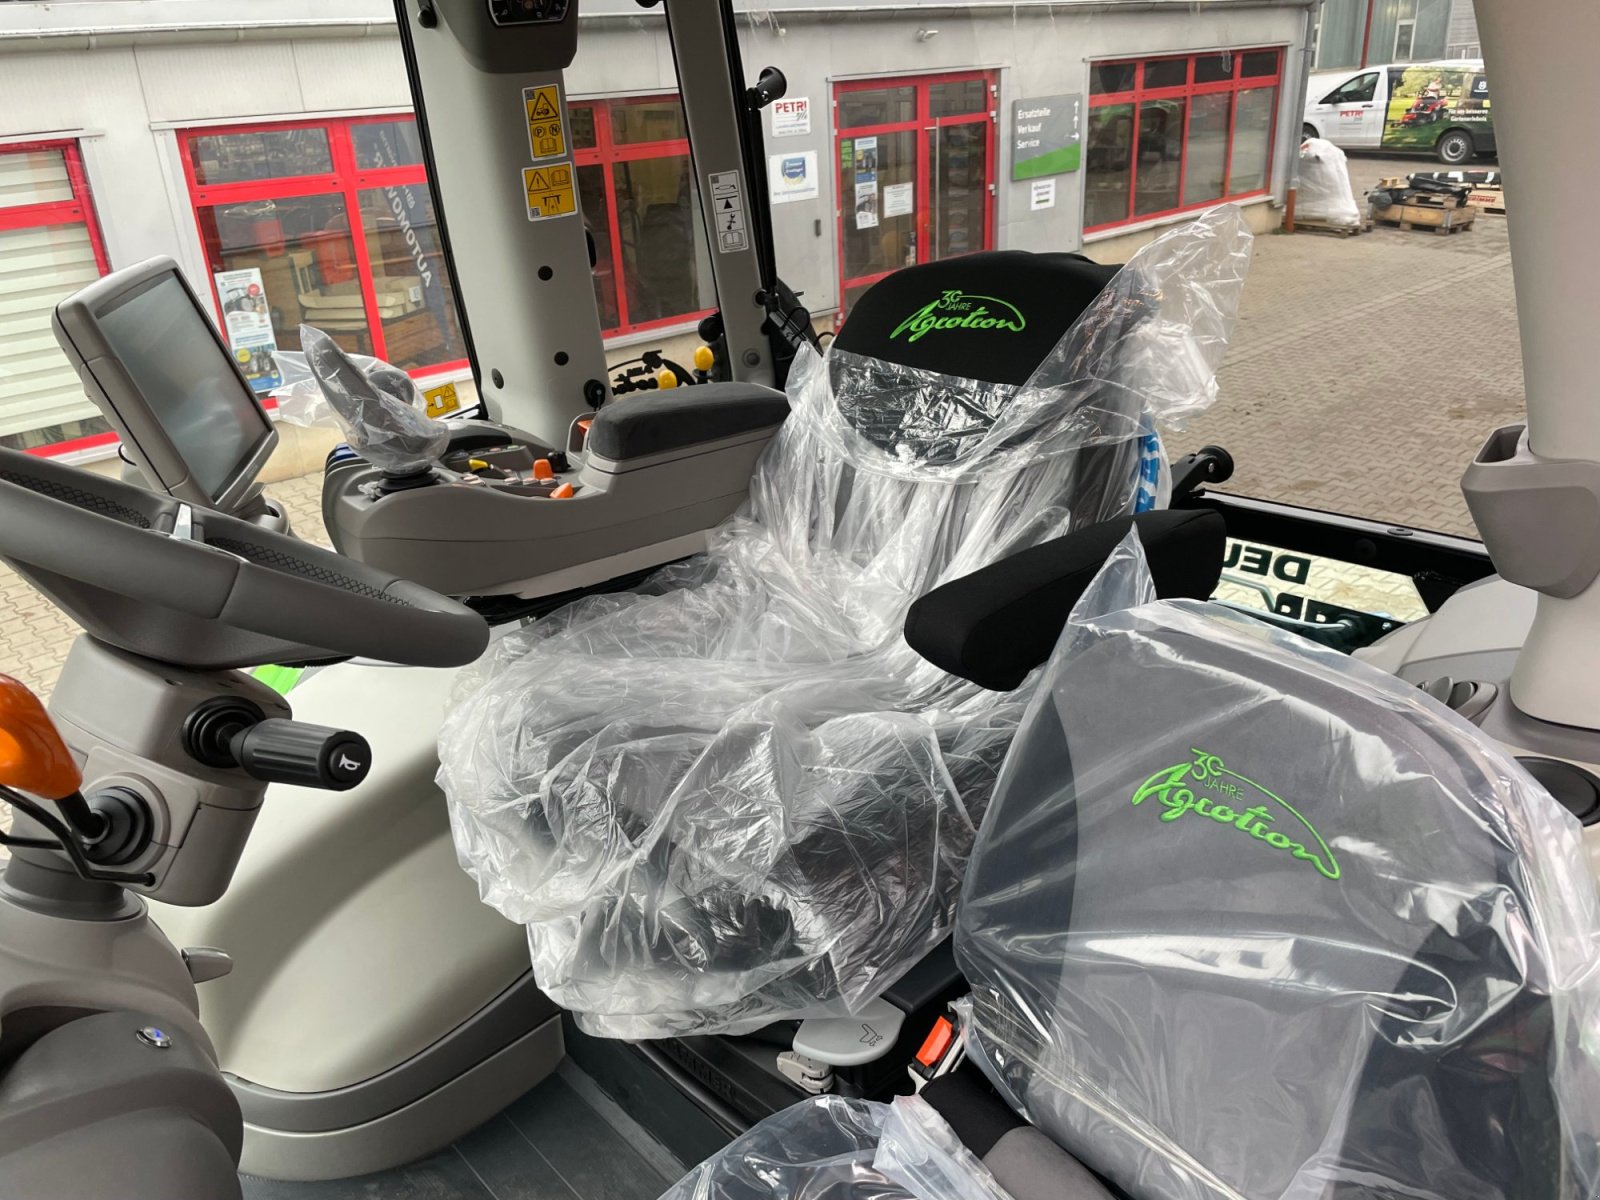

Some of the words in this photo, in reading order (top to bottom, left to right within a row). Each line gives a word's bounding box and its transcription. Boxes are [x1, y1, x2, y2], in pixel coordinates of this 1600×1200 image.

[775, 100, 807, 113] PETRI
[1017, 107, 1051, 119] Ersatzteile
[1017, 122, 1042, 134] Verkauf
[1016, 139, 1040, 149] Service
[946, 302, 972, 311] JAHRE
[1204, 776, 1245, 801] JAHRE
